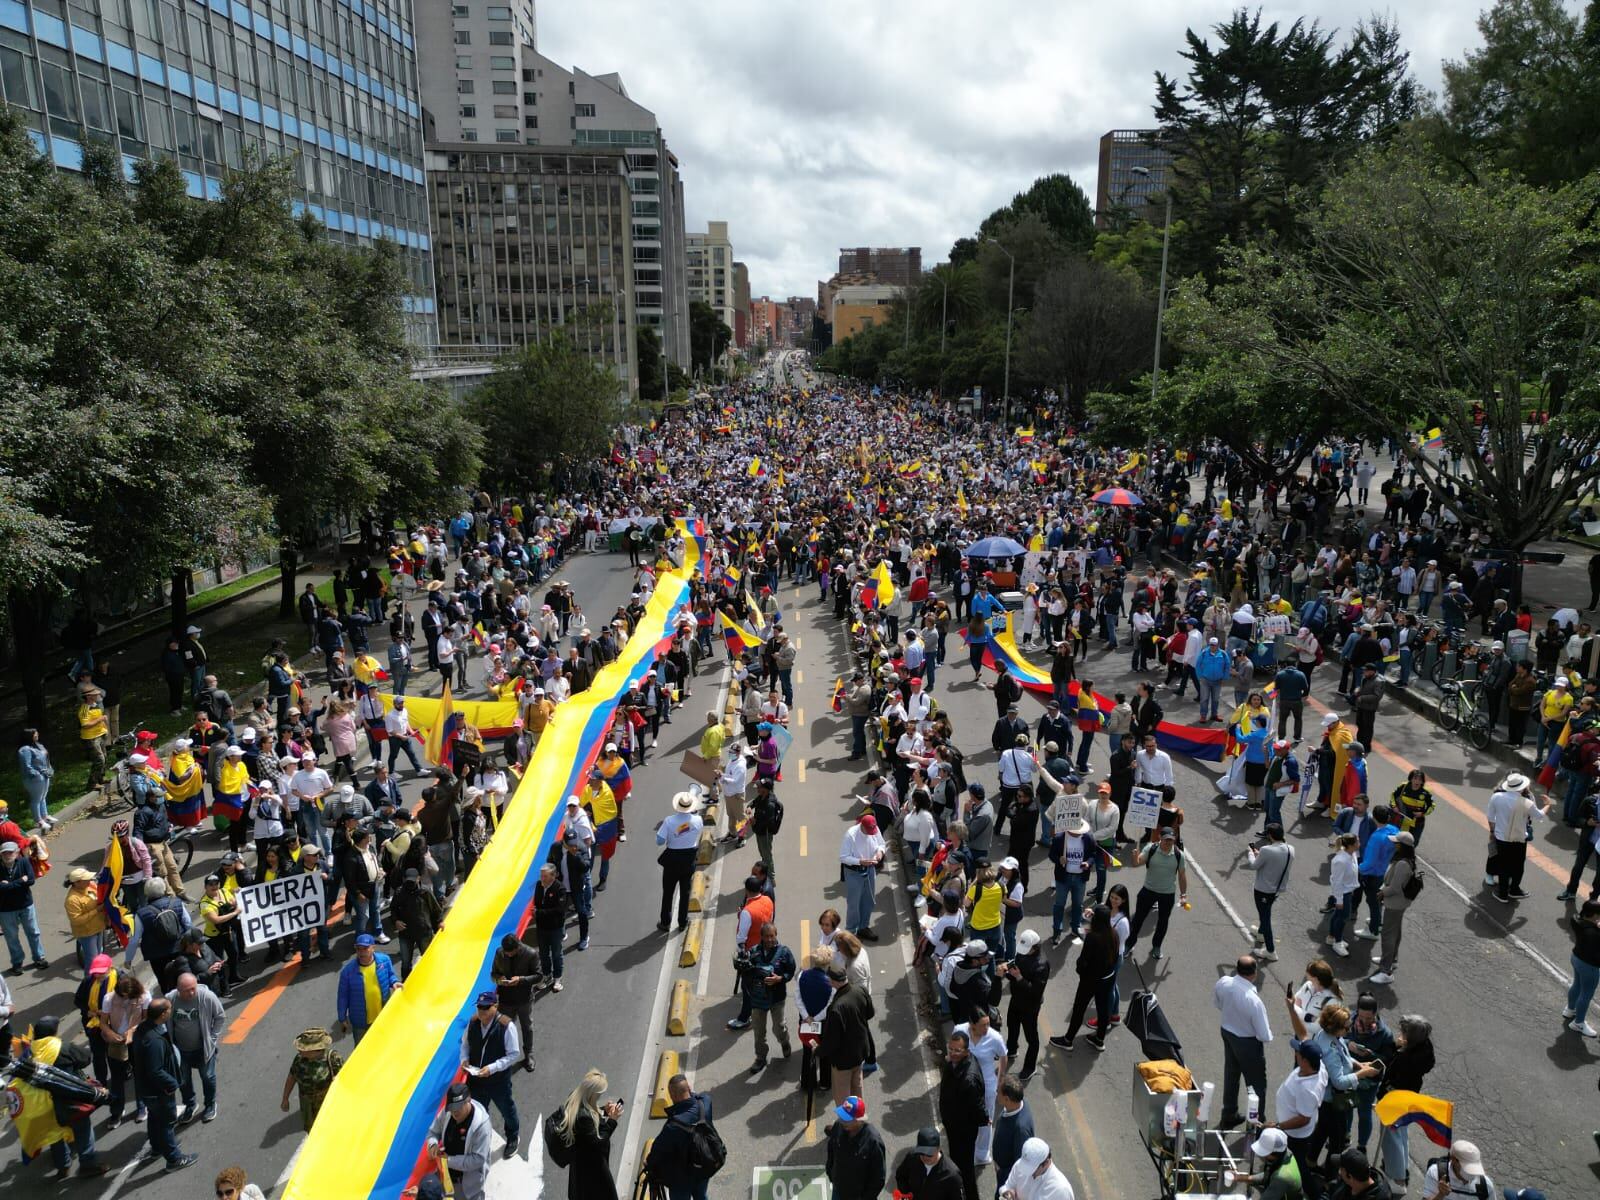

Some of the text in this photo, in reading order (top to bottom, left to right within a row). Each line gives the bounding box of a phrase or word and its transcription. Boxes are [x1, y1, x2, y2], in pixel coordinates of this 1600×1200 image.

[1133, 791, 1159, 807] SI
[1057, 811, 1080, 820] PETRO
[241, 875, 318, 914] FUERA
[247, 901, 321, 943] PETRO
